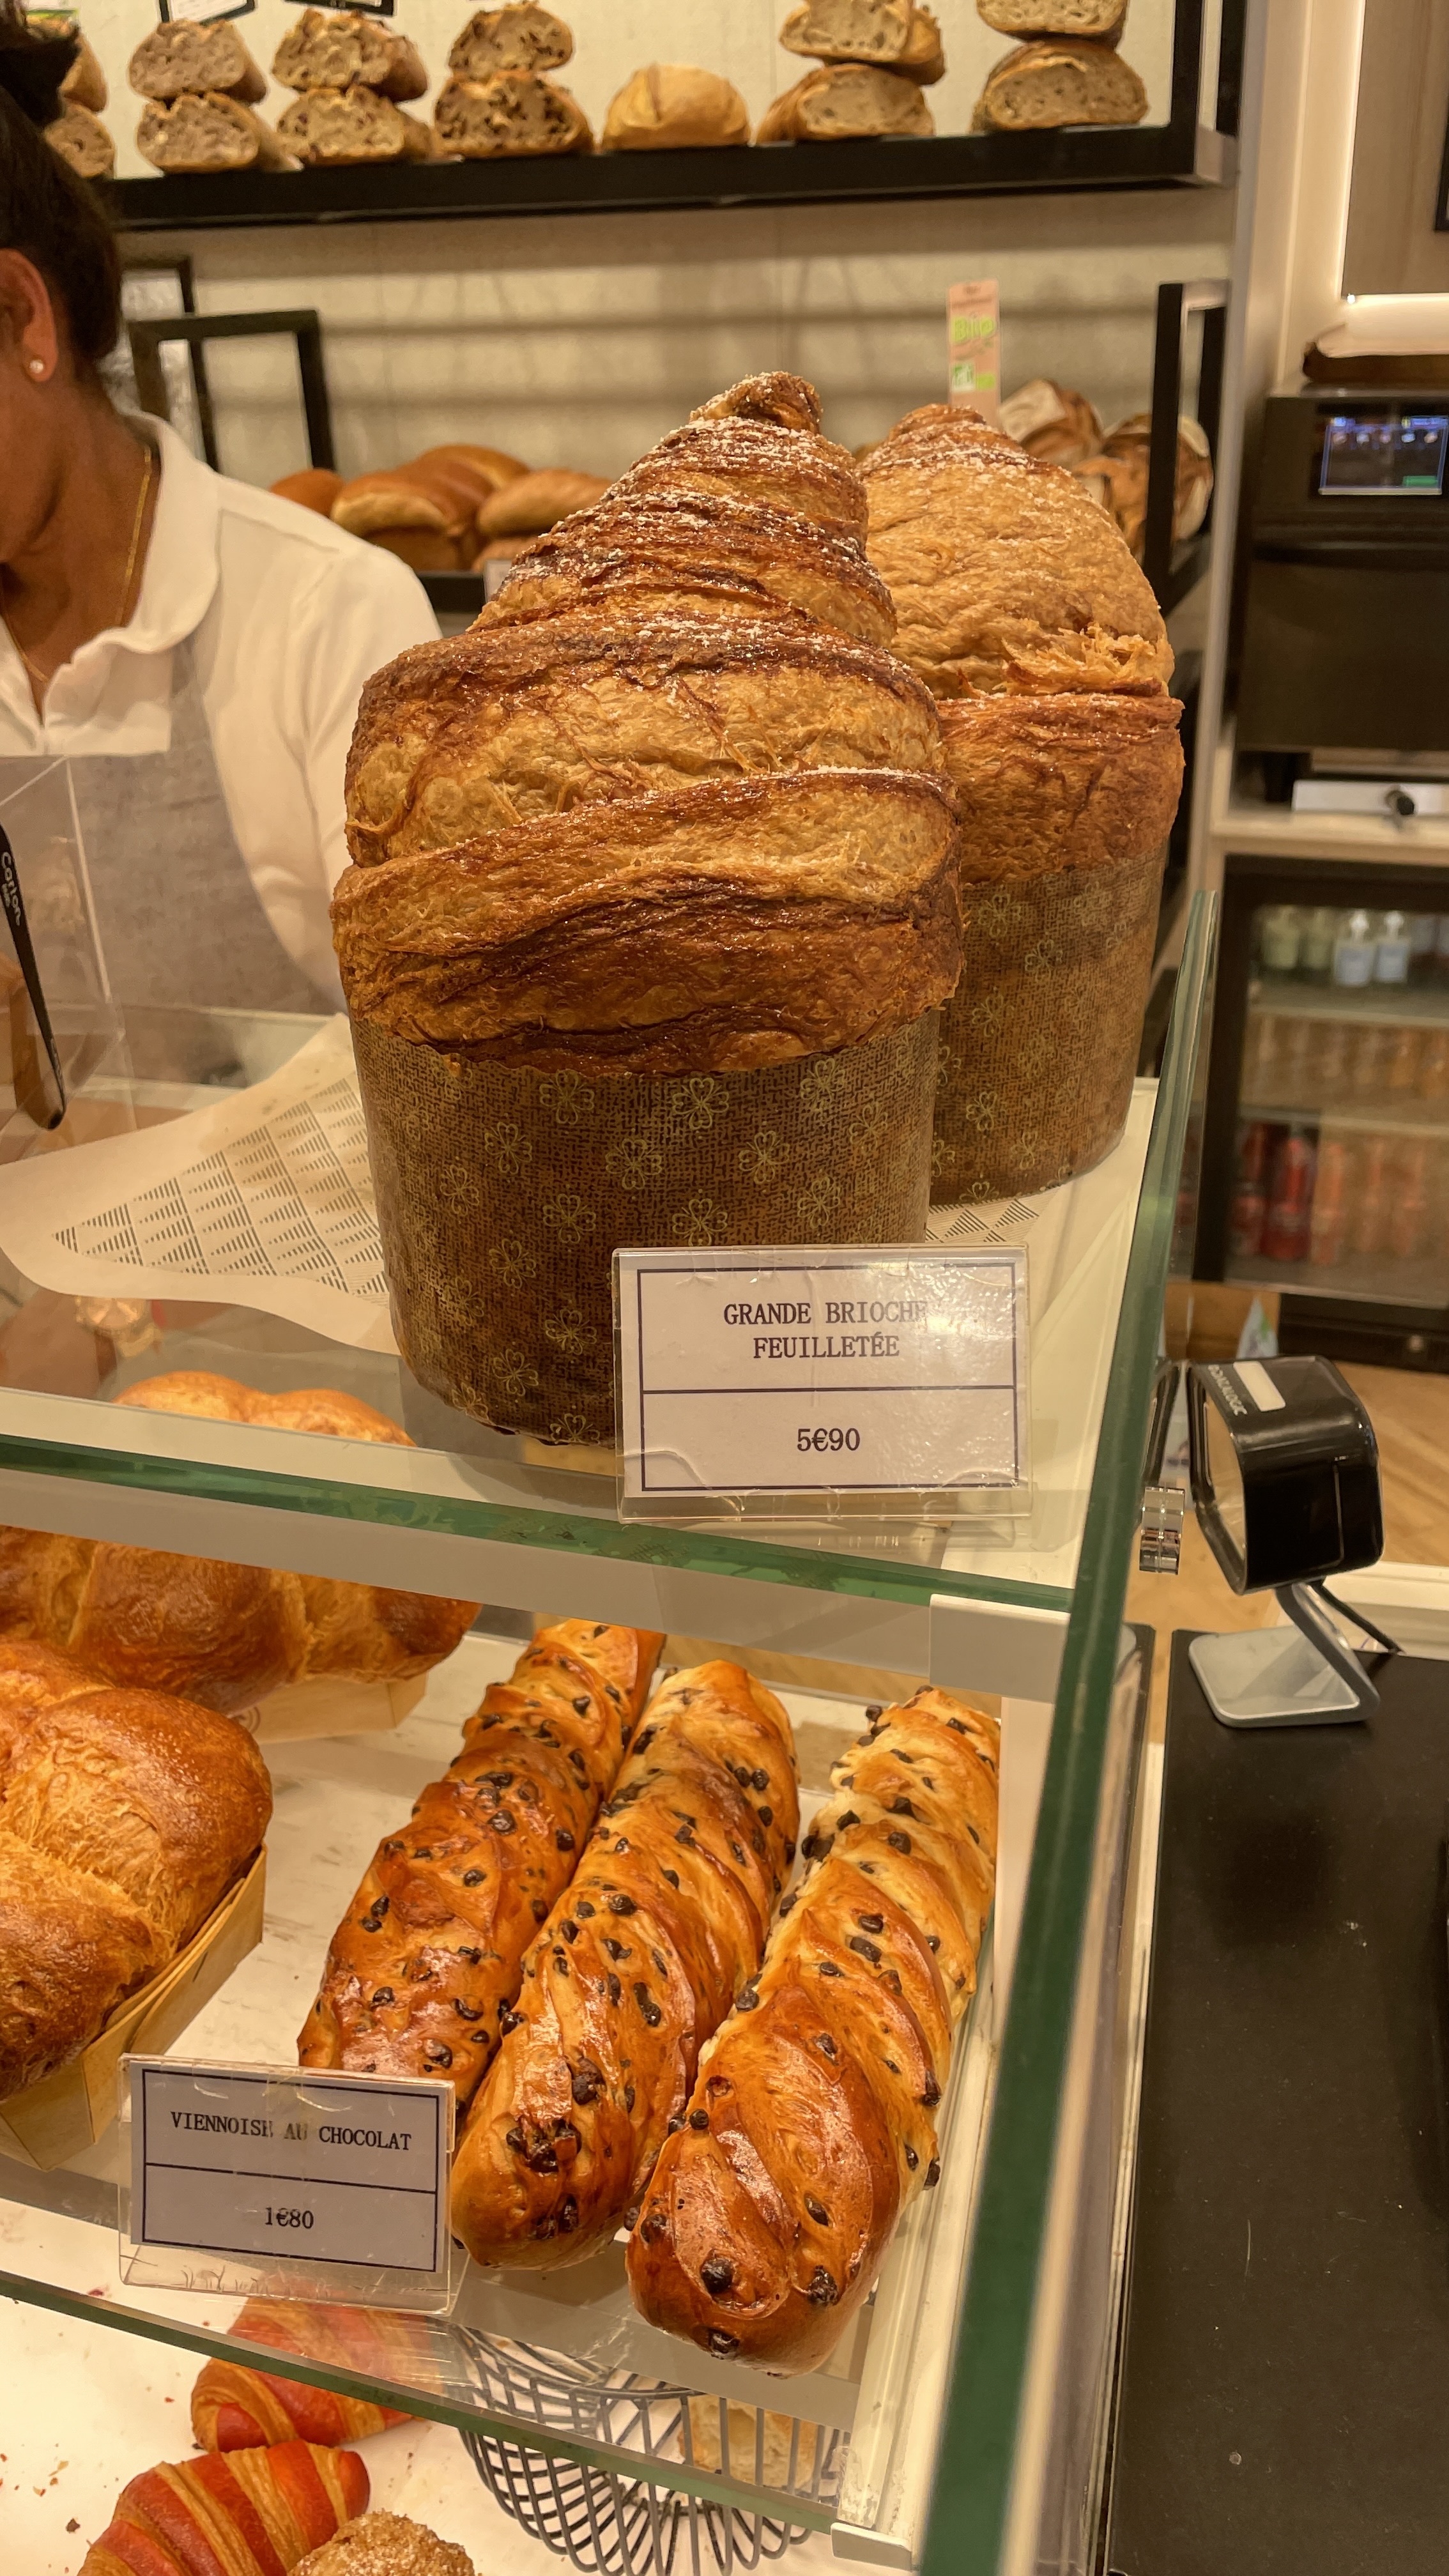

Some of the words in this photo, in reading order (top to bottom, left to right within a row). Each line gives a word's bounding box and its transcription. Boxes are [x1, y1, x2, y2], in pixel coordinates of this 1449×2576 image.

[724, 1303, 811, 1324] GRANDE
[753, 1331, 900, 1358] FEUILLETÉE
[797, 1428, 860, 1452] 5€90
[284, 2122, 308, 2140] AU
[319, 2126, 411, 2150] CHOCOLAT
[265, 2207, 314, 2229] 1€80
